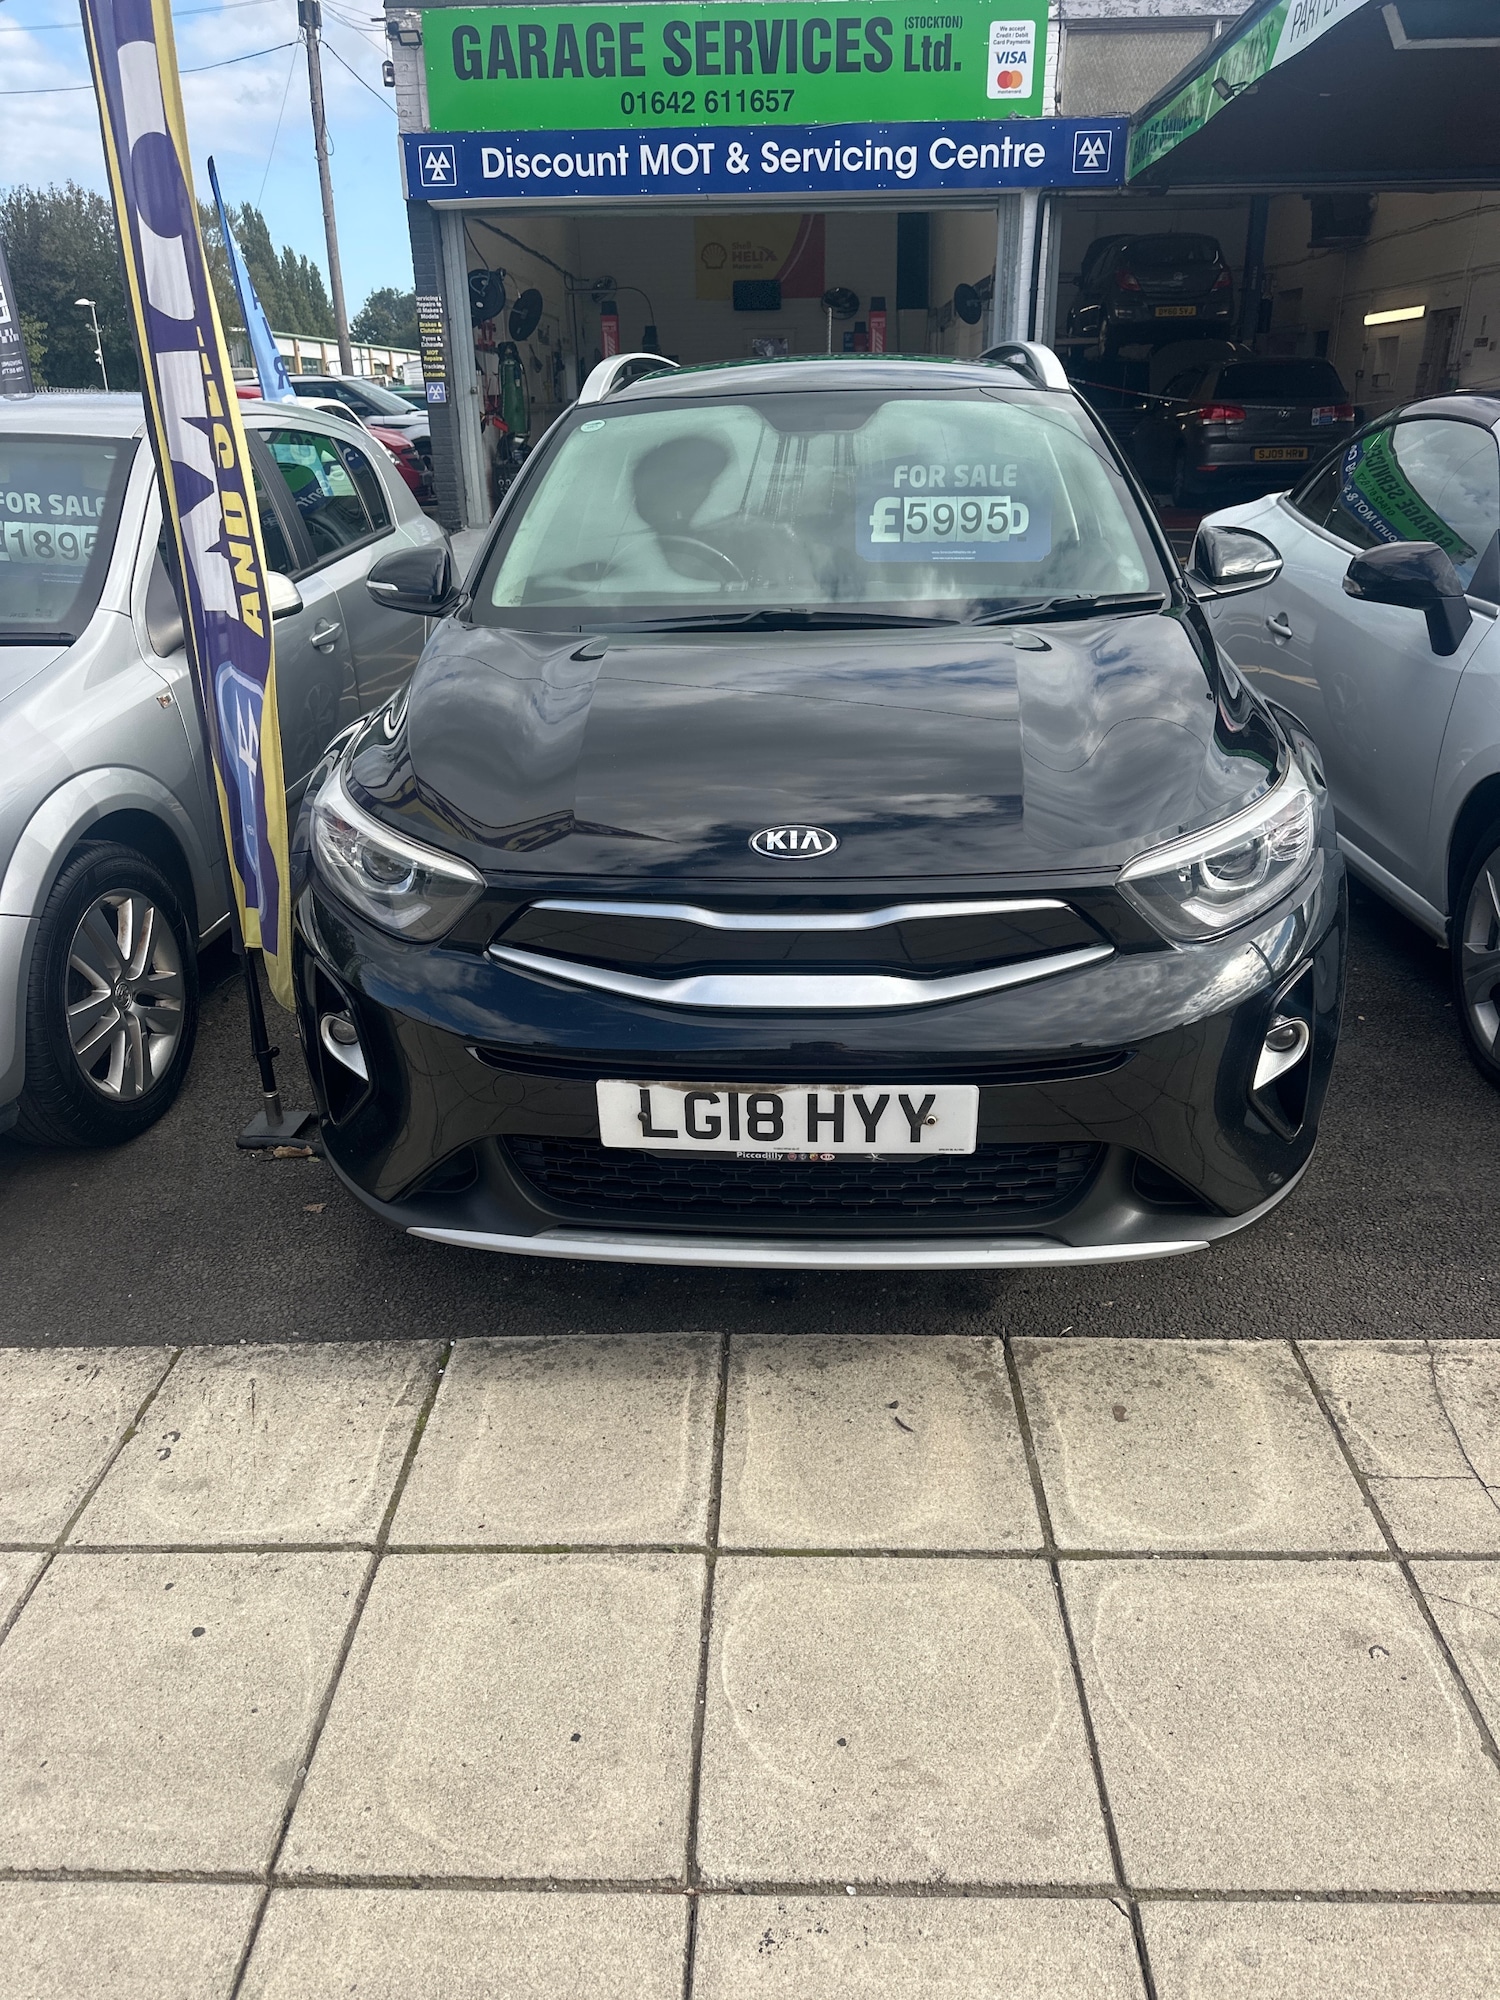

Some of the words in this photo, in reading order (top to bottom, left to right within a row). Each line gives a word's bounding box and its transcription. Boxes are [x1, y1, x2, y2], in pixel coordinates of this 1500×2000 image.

[904, 15, 963, 30] (STOCKTON)
[452, 22, 646, 81] GARAGE
[663, 17, 894, 77] SERVICES
[904, 33, 962, 72] Ltd.
[994, 50, 1027, 64] VISA
[620, 91, 696, 115] 01642
[704, 89, 795, 113] 611657
[481, 145, 629, 179] Discount
[640, 142, 715, 176] MOT
[726, 141, 750, 174] &
[760, 139, 918, 180] Servicing
[929, 136, 1046, 170] Centre
[732, 249, 779, 262] HELIX
[1259, 449, 1284, 459] SJ09
[893, 464, 946, 488] FOR
[954, 463, 1018, 487] SALE
[0, 491, 43, 514] OR
[221, 490, 264, 639] AND
[766, 829, 823, 851] KIA
[640, 1088, 784, 1141] LG18
[806, 1093, 937, 1143] HYY
[736, 1151, 784, 1161] Piccadilly
